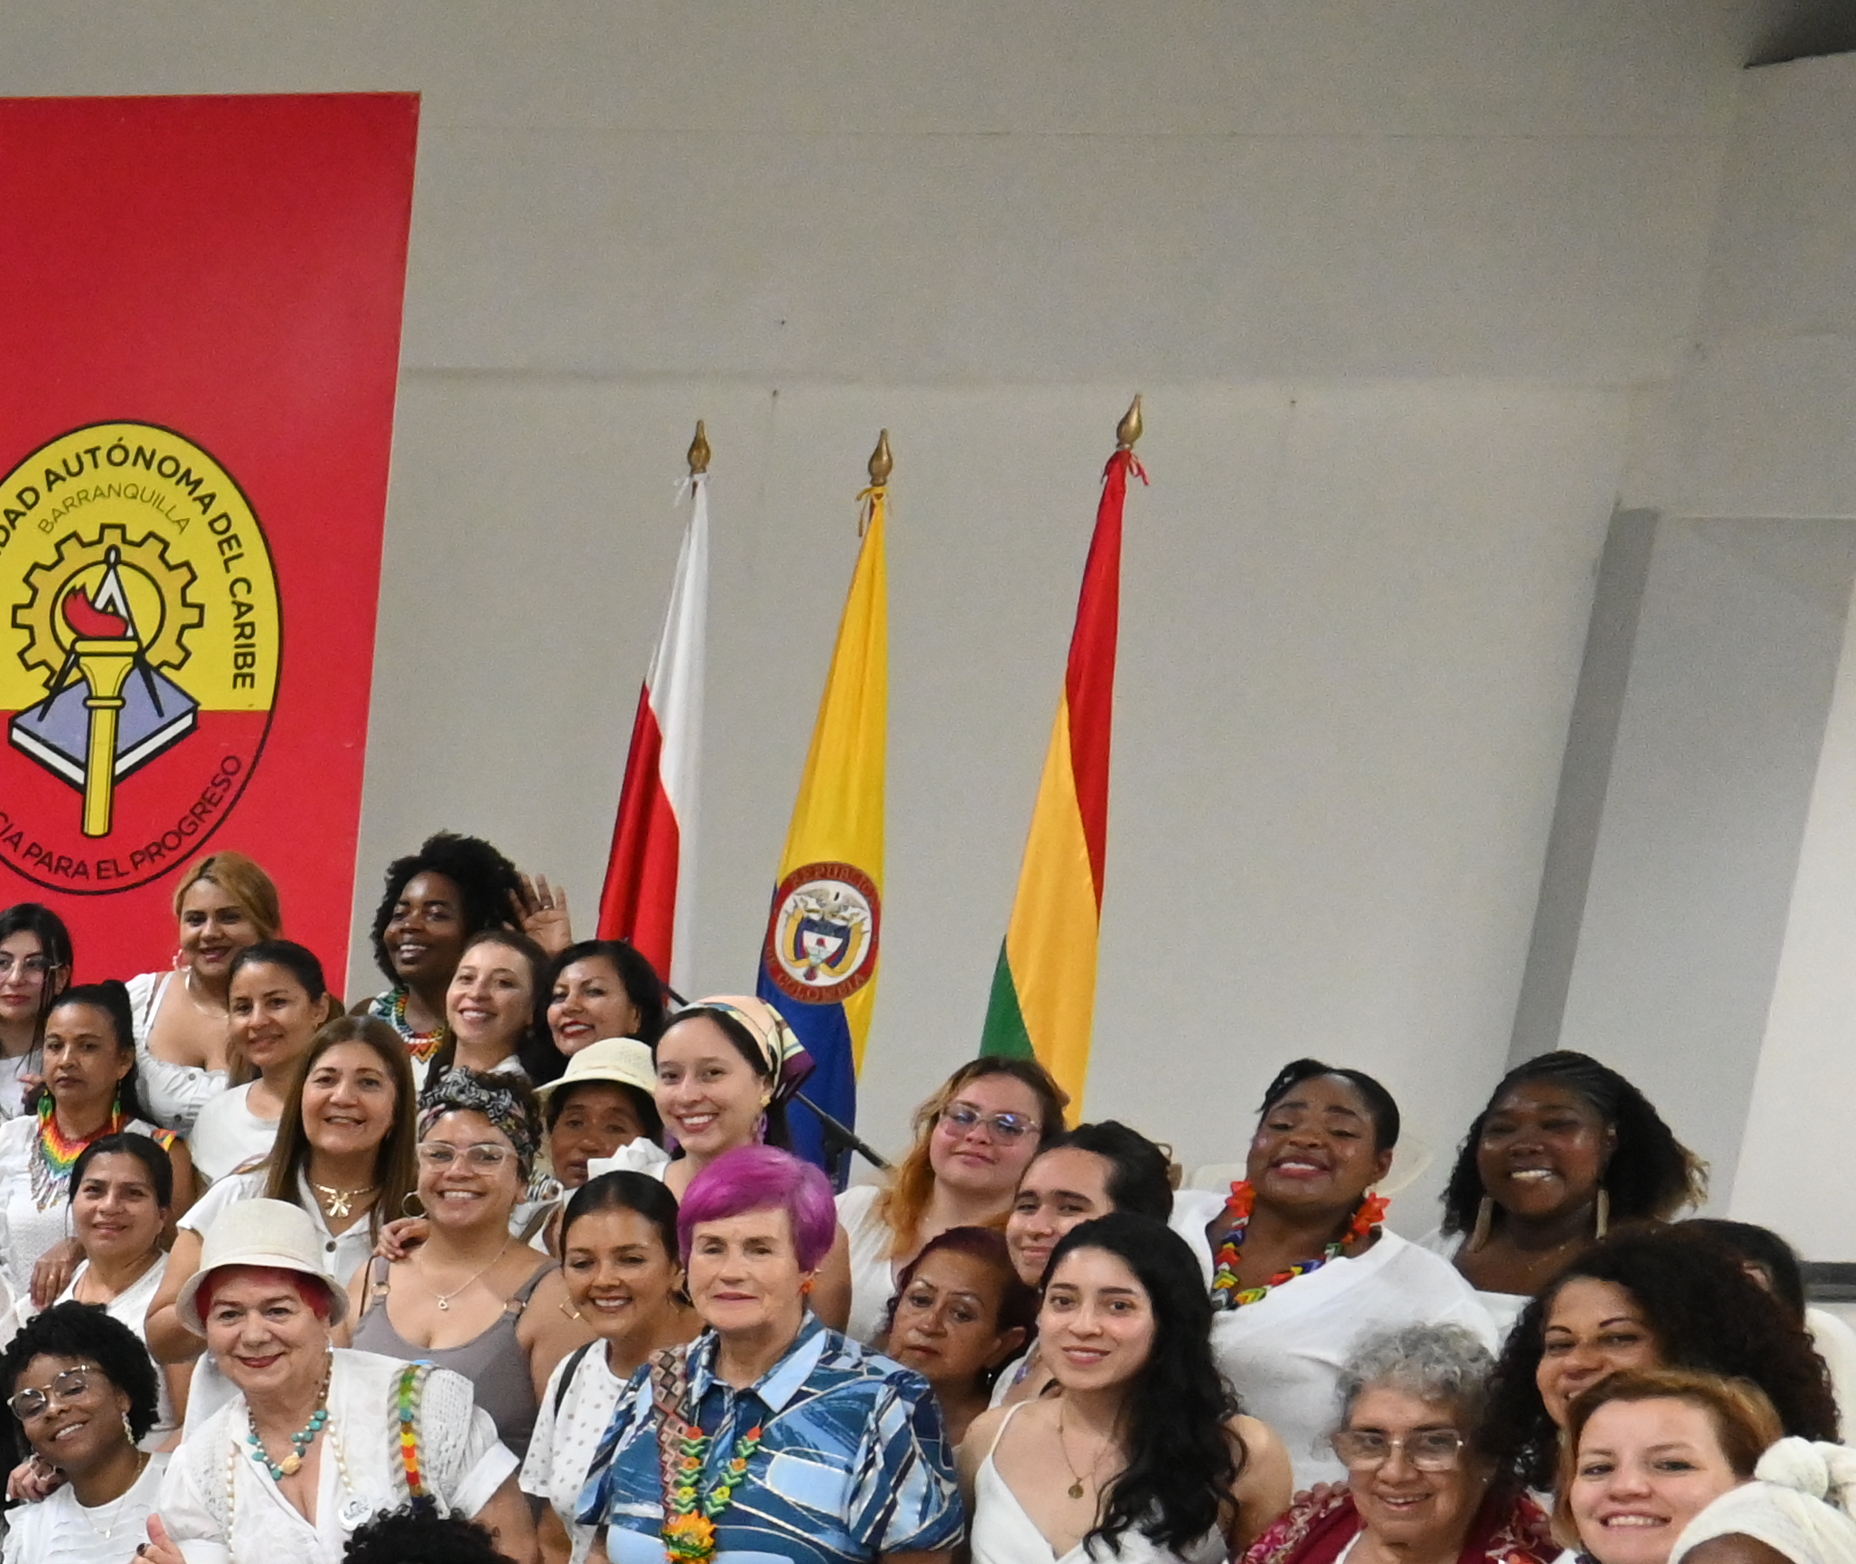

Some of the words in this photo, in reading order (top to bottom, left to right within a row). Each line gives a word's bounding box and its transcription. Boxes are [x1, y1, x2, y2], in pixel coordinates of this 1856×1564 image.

[37, 482, 191, 536] BARRANQUILLA
[45, 436, 219, 516] AUTÓNOMA
[208, 512, 244, 574] DEL
[228, 576, 256, 690] CARIBE
[23, 841, 90, 880] PARA
[96, 858, 129, 880] EL
[129, 754, 242, 871] PROGRESO
